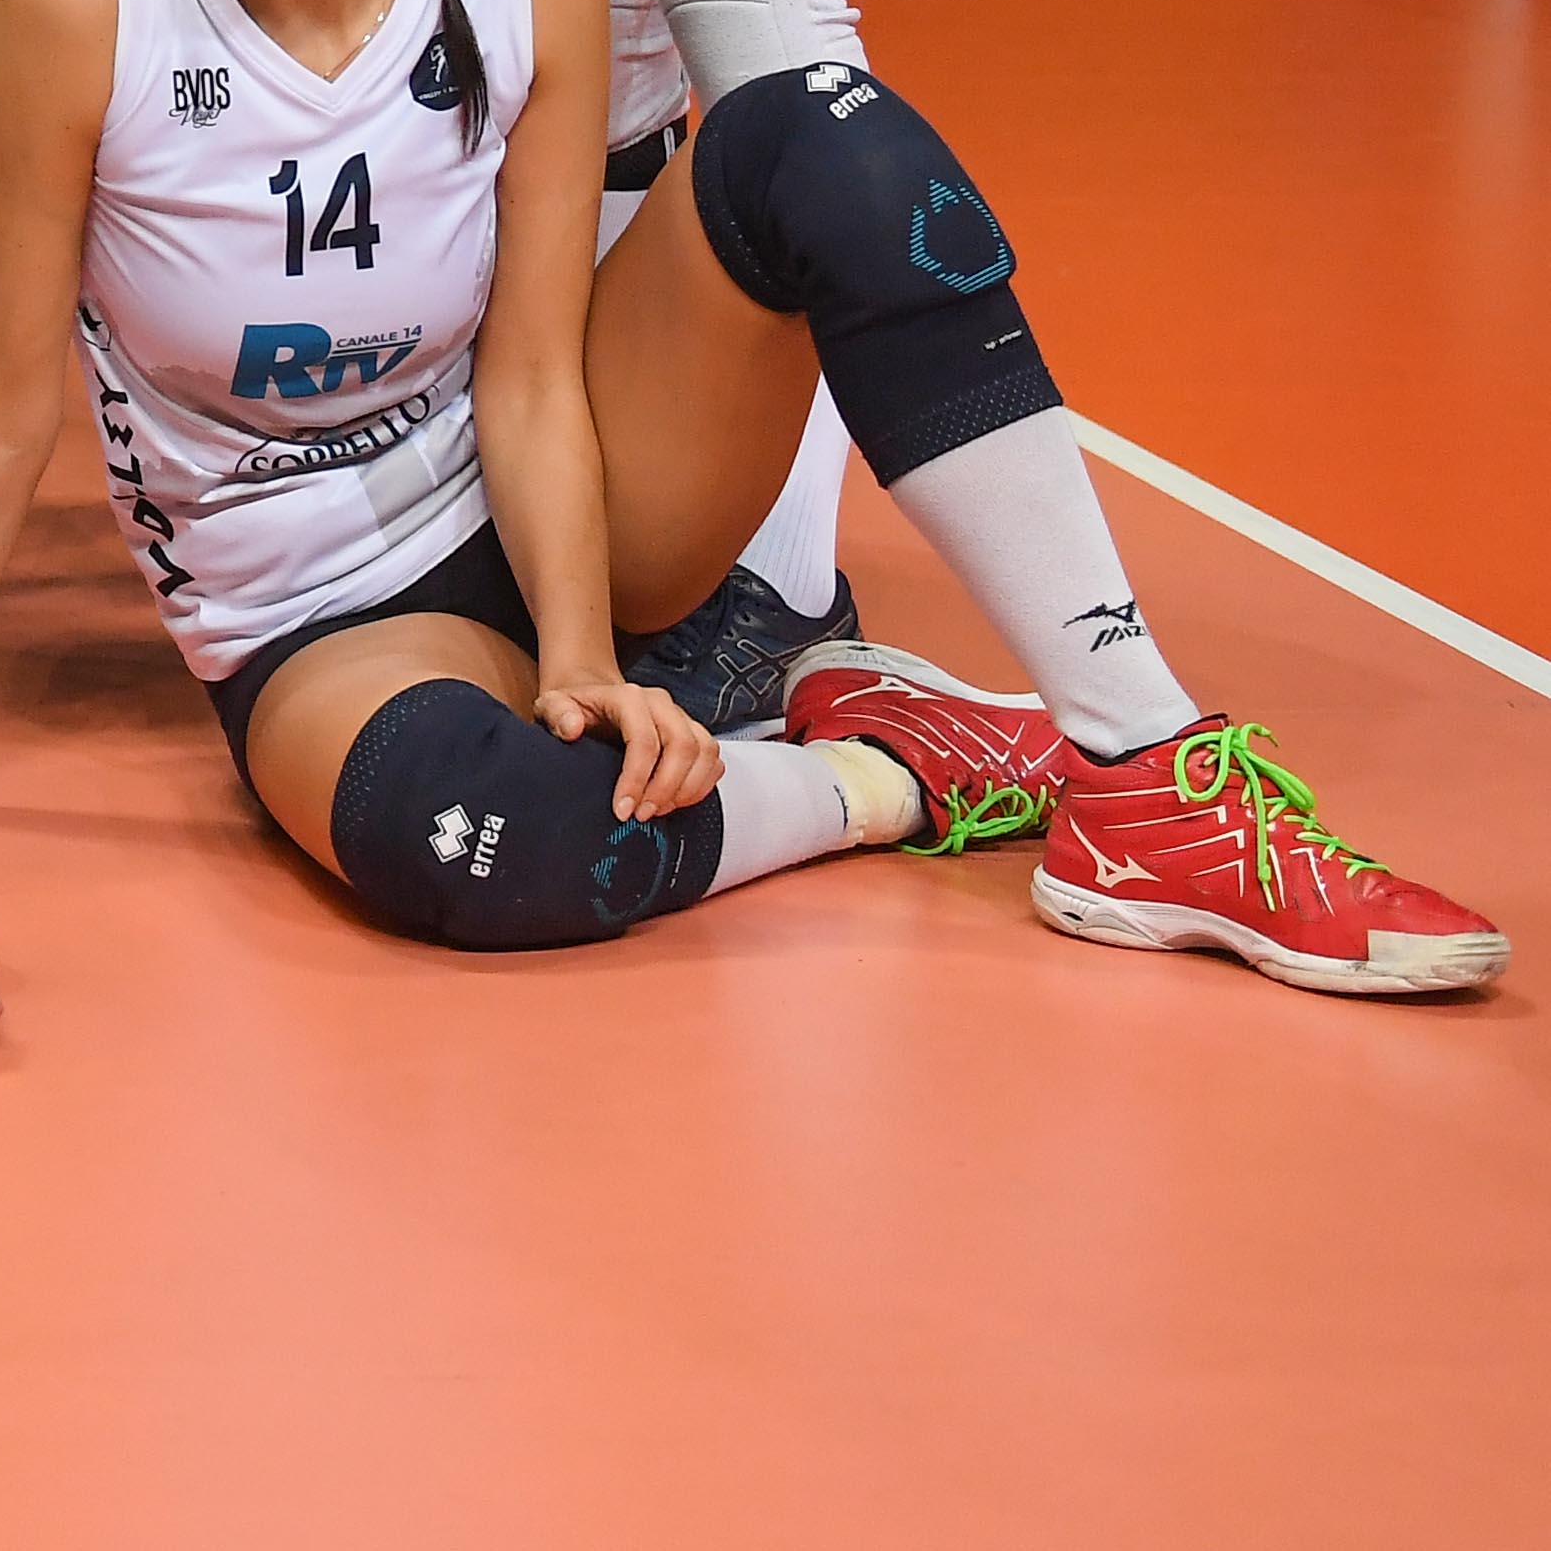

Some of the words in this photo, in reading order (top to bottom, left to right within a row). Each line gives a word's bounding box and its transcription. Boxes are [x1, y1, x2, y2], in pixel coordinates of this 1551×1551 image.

[172, 67, 231, 111] BVOS
[269, 151, 381, 277] 14
[336, 331, 398, 348] CANALE
[402, 324, 422, 339] 14
